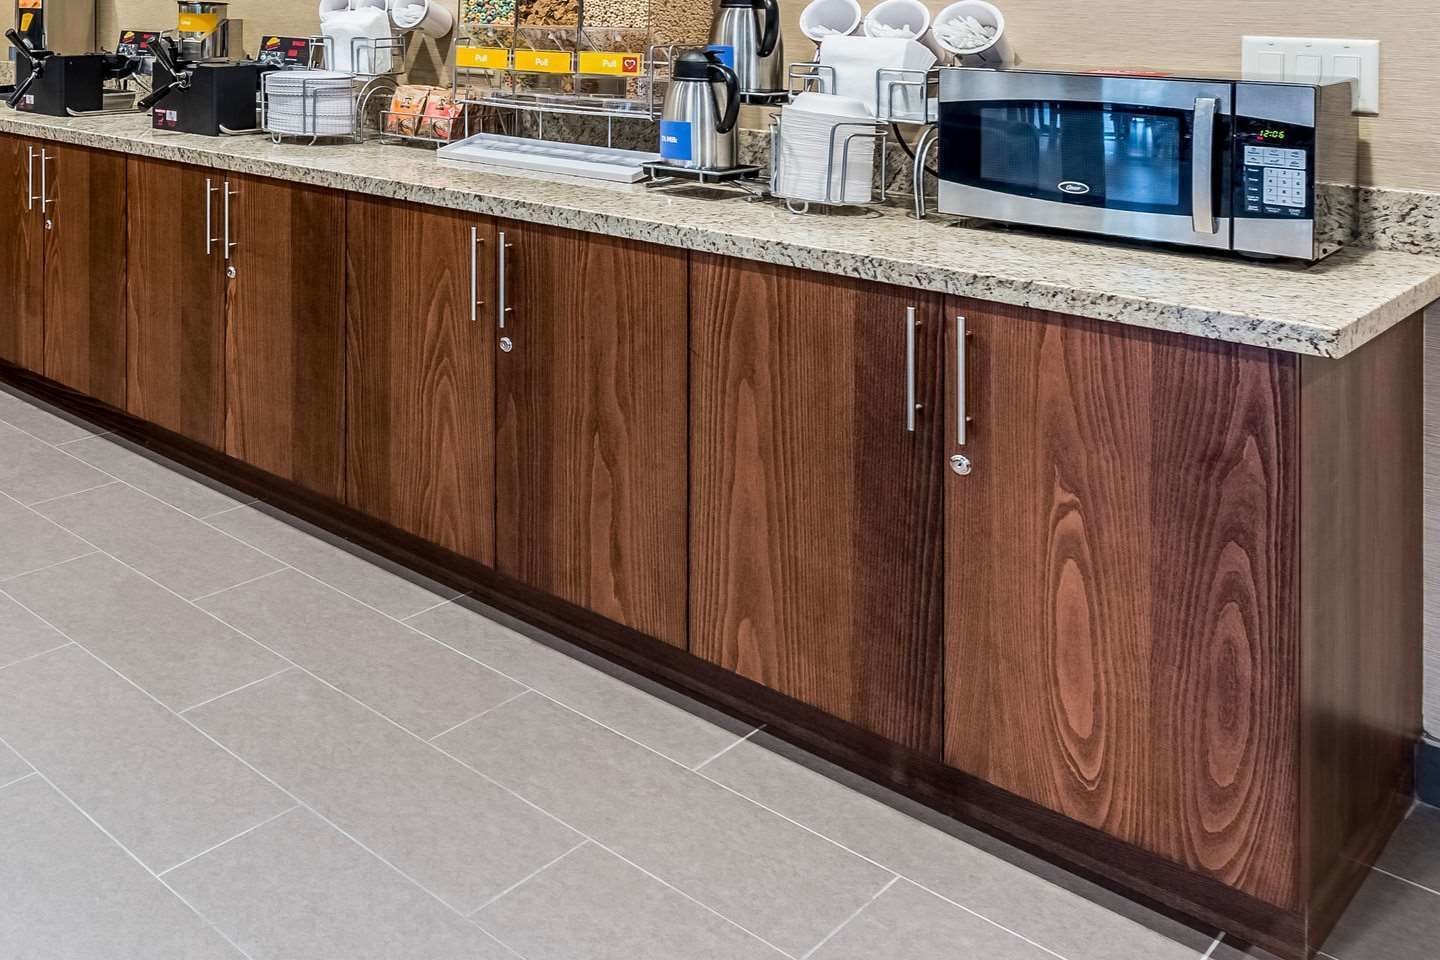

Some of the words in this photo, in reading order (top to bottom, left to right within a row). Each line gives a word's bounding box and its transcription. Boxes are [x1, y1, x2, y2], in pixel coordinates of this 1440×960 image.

[475, 54, 488, 63] Pull
[535, 57, 548, 66] Pull
[602, 59, 616, 68] Pull
[1260, 129, 1286, 139] 12:06
